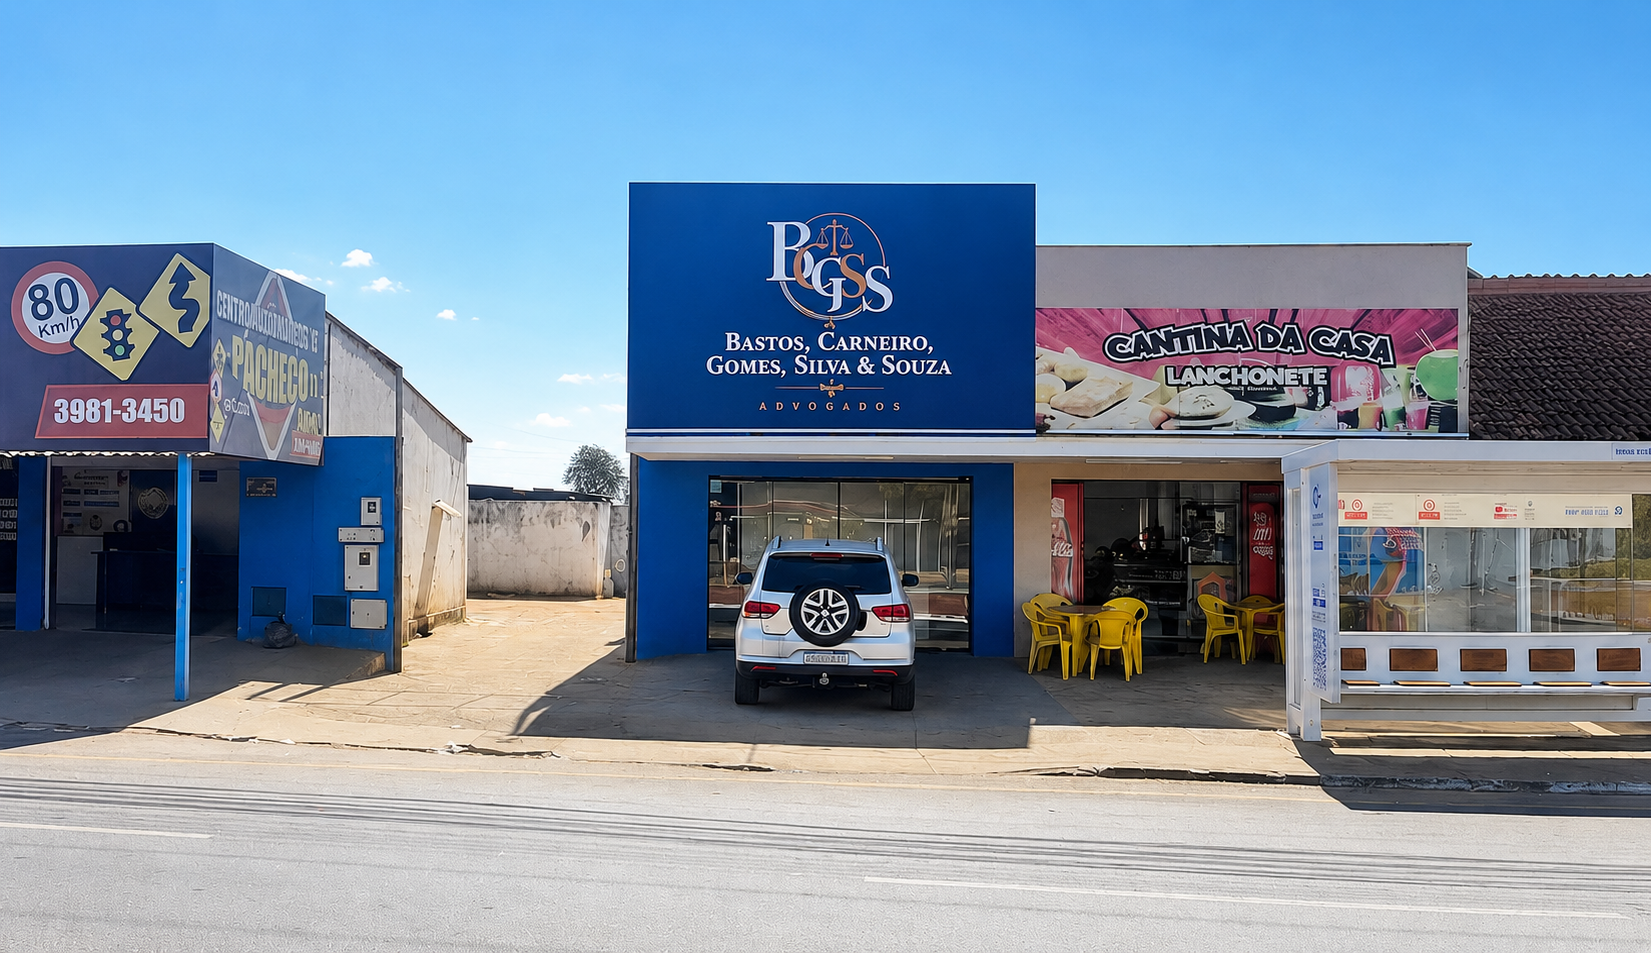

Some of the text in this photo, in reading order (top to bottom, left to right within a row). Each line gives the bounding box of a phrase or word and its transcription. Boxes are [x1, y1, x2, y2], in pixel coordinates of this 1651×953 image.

[27, 277, 80, 321] 80
[1104, 322, 1394, 364] CANTINA DA CASA
[794, 355, 850, 376] SILVA
[857, 356, 875, 375] &
[881, 355, 952, 375] SOUZA
[1167, 367, 1327, 386] LANCHONETE
[54, 397, 185, 423] 3981-3450
[760, 402, 901, 411] ADVOGADOS
